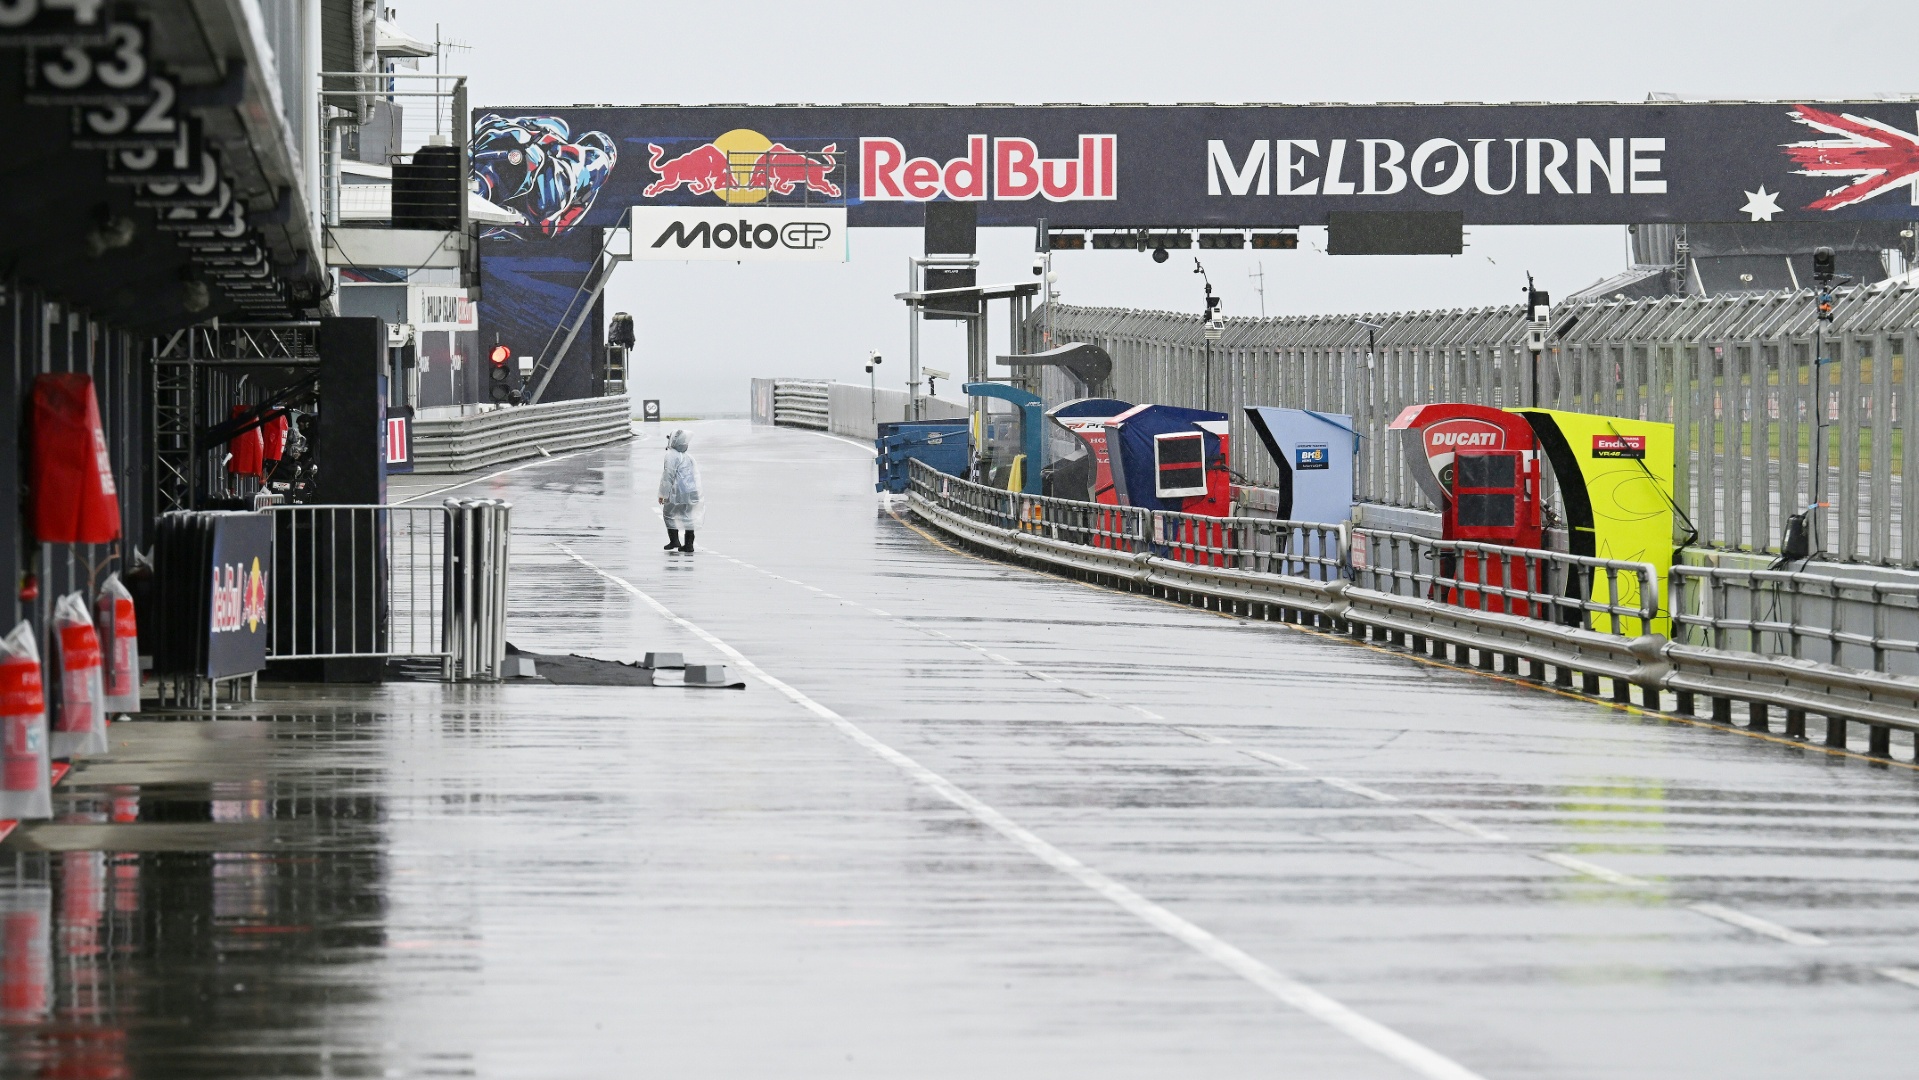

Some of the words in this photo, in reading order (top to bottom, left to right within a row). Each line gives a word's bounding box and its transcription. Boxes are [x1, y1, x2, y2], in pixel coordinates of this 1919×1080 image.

[860, 134, 987, 202] Red
[994, 134, 1117, 202] Bull
[1207, 137, 1668, 196] MELBOURNE
[650, 219, 831, 250] MotoGP
[1431, 432, 1497, 446] DUCATI
[1598, 440, 1640, 448] Enduro
